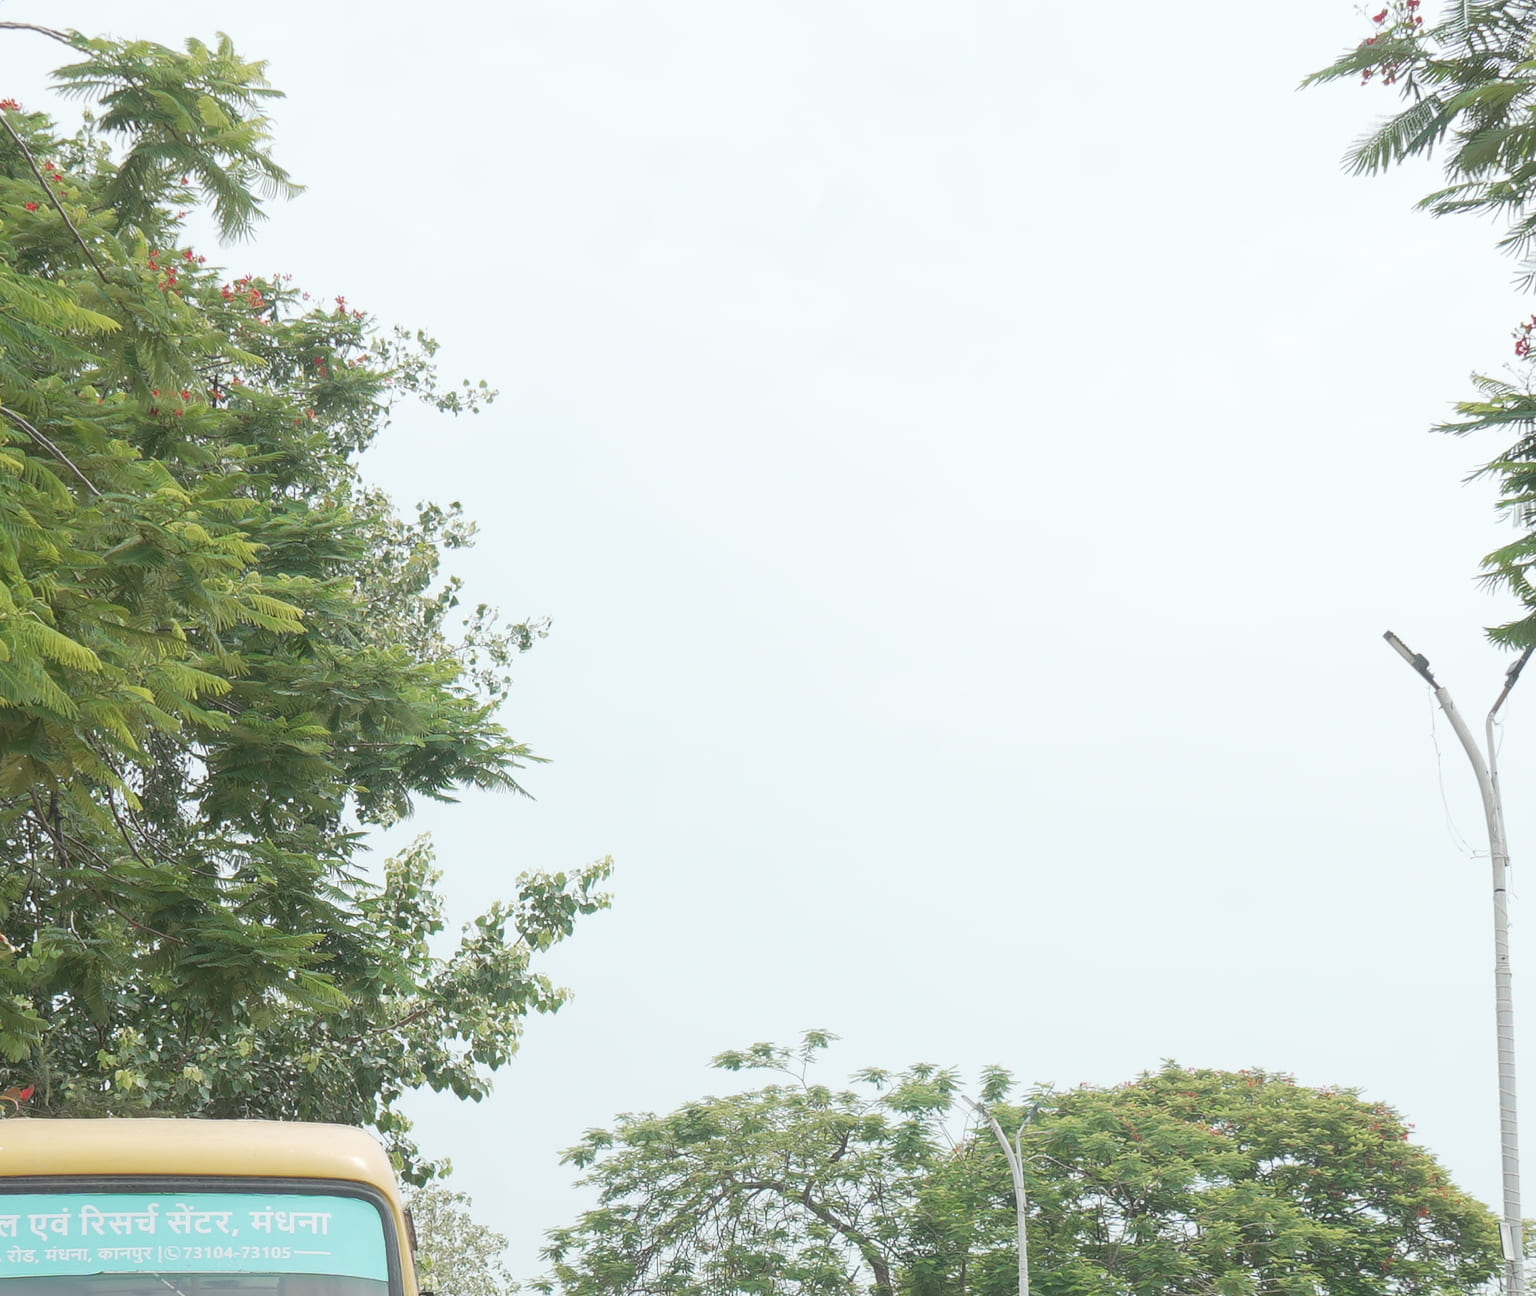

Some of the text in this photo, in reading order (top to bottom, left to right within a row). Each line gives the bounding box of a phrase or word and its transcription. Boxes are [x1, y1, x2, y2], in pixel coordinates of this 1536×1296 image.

[28, 1207, 71, 1241] एवं
[80, 1203, 160, 1235] रिसर्च
[166, 1203, 240, 1238] सेंटर,
[249, 1206, 332, 1235] मंधना
[7, 1245, 39, 1264] रोड,
[46, 1246, 92, 1263] मंधना,
[98, 1248, 154, 1265] कानपुर
[184, 1247, 291, 1260] 73104-73105
